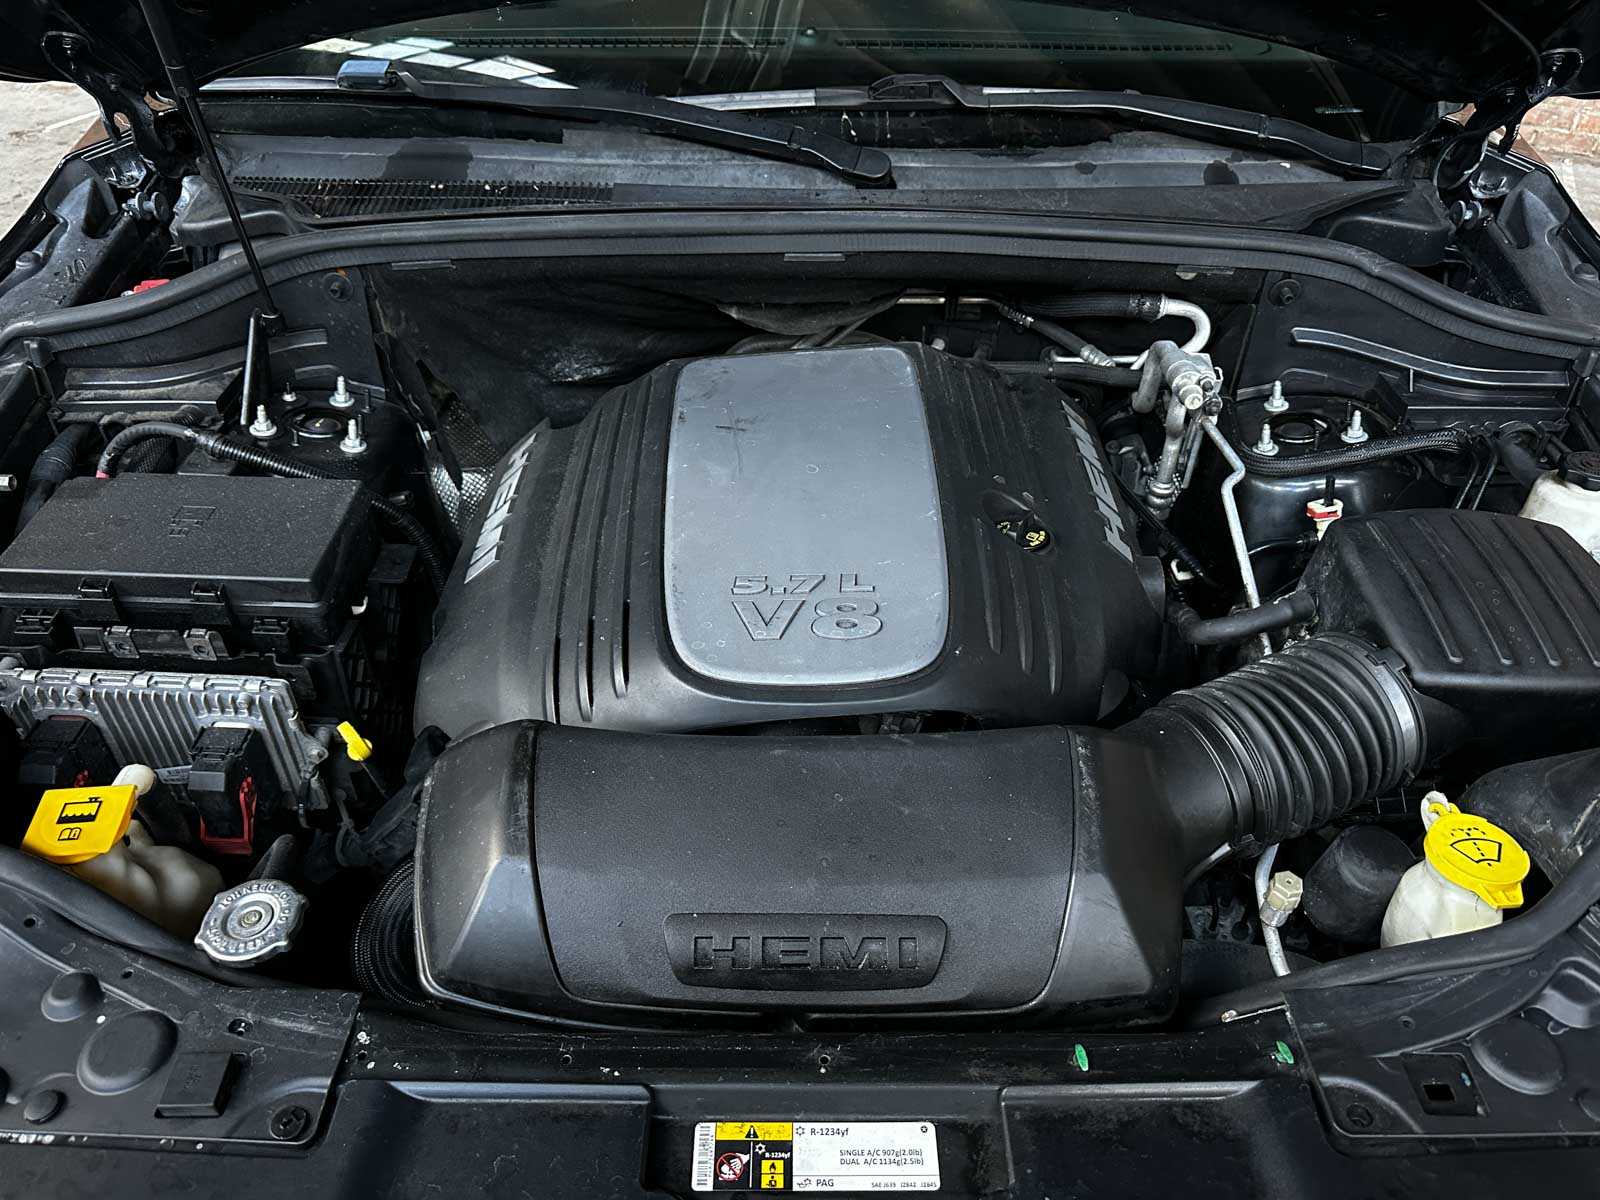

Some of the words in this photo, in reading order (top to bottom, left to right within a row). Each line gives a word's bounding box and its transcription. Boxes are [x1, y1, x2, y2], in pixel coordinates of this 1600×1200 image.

[1061, 399, 1134, 563] HEMI
[464, 432, 537, 584] HEMI
[731, 599, 883, 641] V8
[693, 936, 918, 970] HEMI
[810, 1127, 849, 1138] R-1234yf
[840, 1149, 865, 1157] SINGLE
[867, 1149, 881, 1157] A/C
[840, 1158, 860, 1166] DUAL
[864, 1158, 879, 1166] A/C
[816, 1179, 834, 1187] PAG
